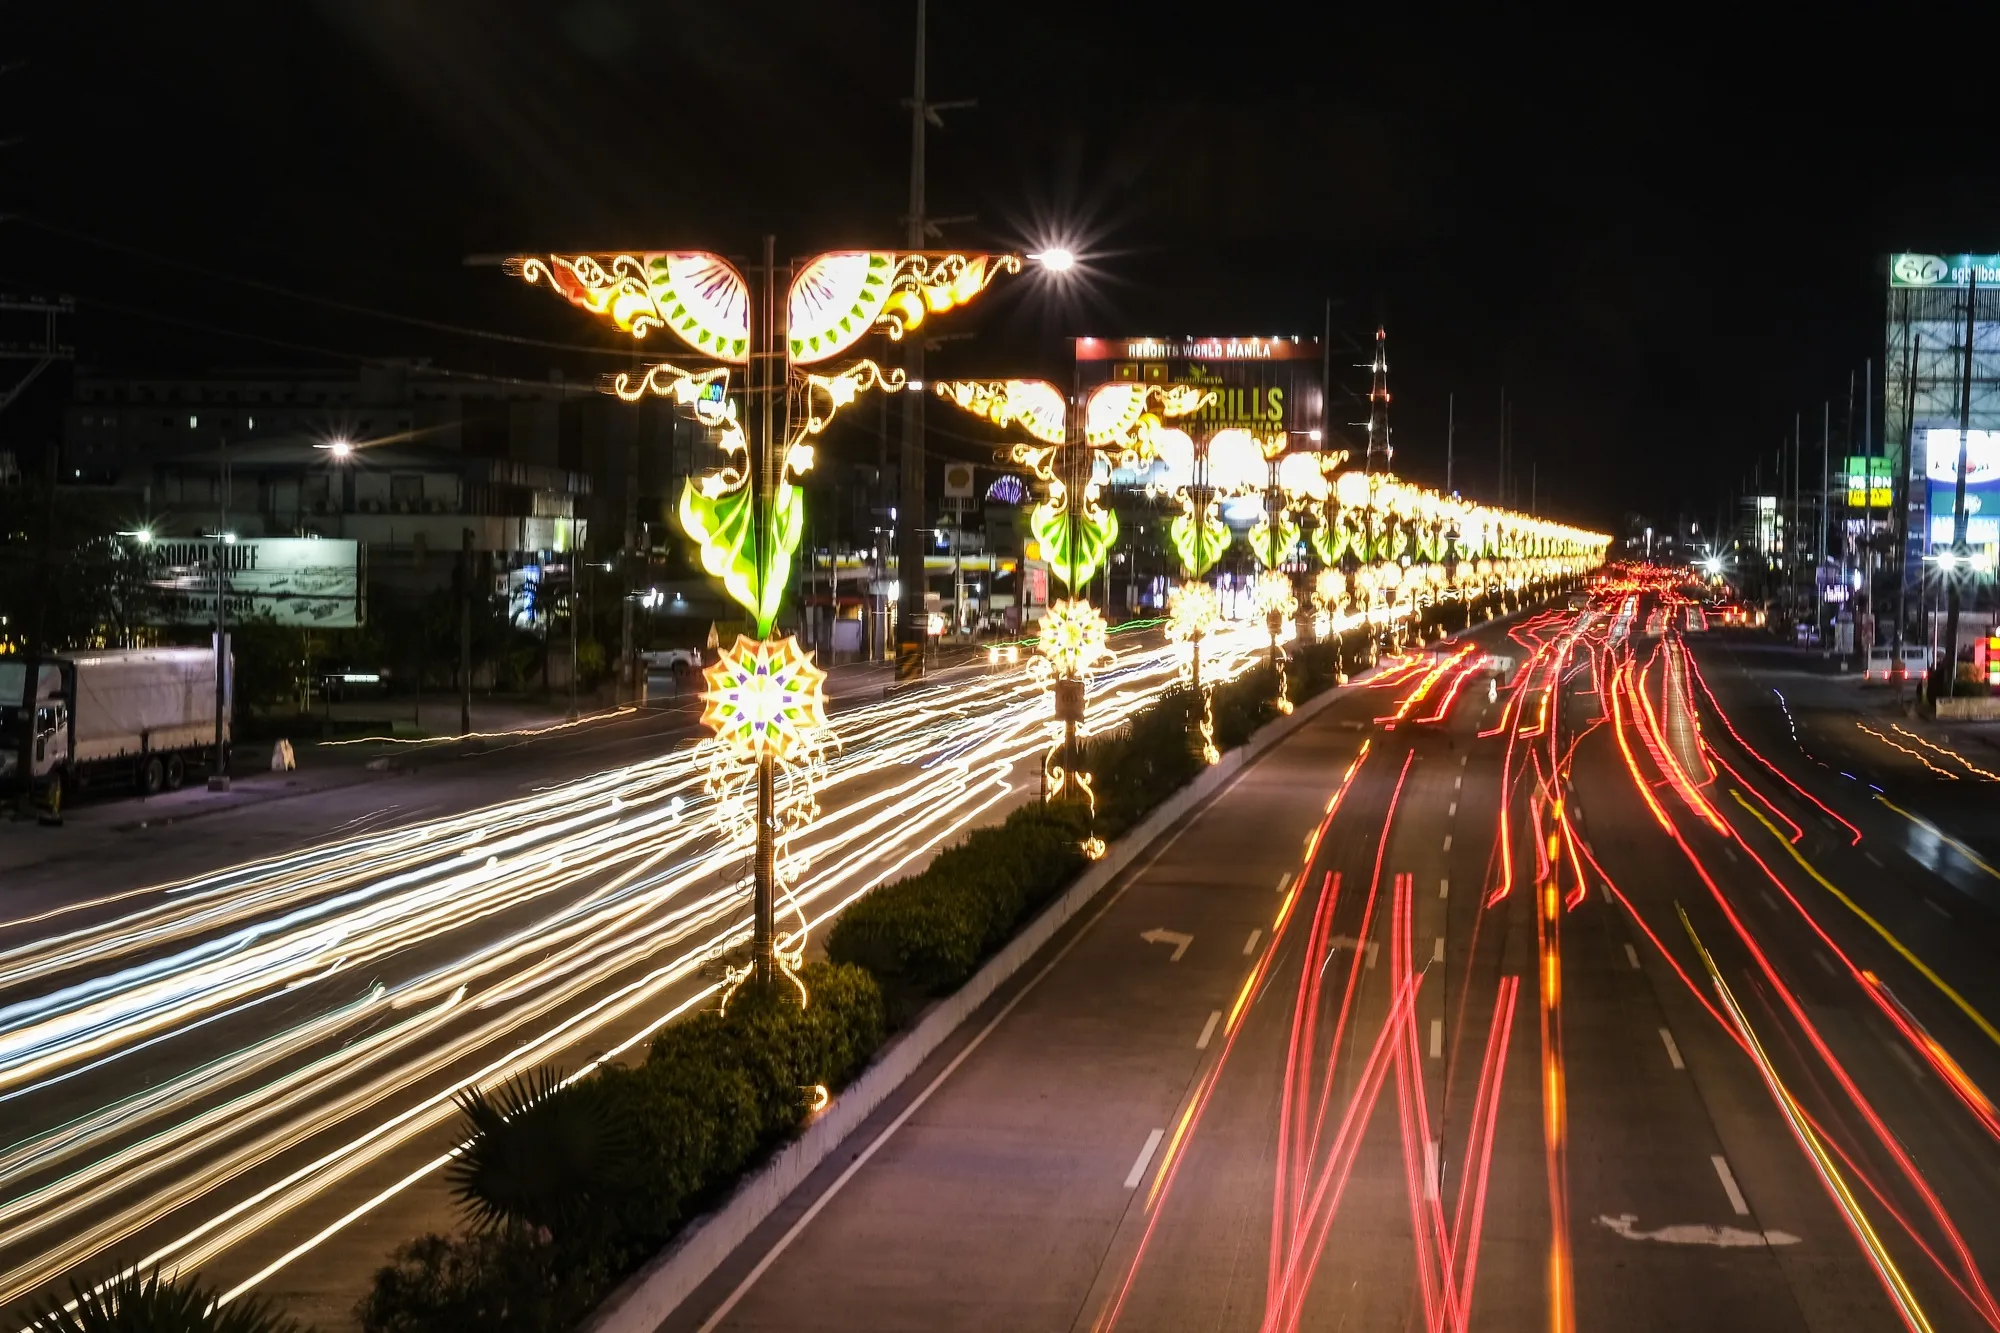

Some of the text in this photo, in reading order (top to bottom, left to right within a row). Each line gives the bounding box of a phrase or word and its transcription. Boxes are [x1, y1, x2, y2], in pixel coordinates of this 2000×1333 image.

[1128, 343, 1271, 359] RESORTS WORLD MANILA
[212, 544, 259, 570] STUFF
